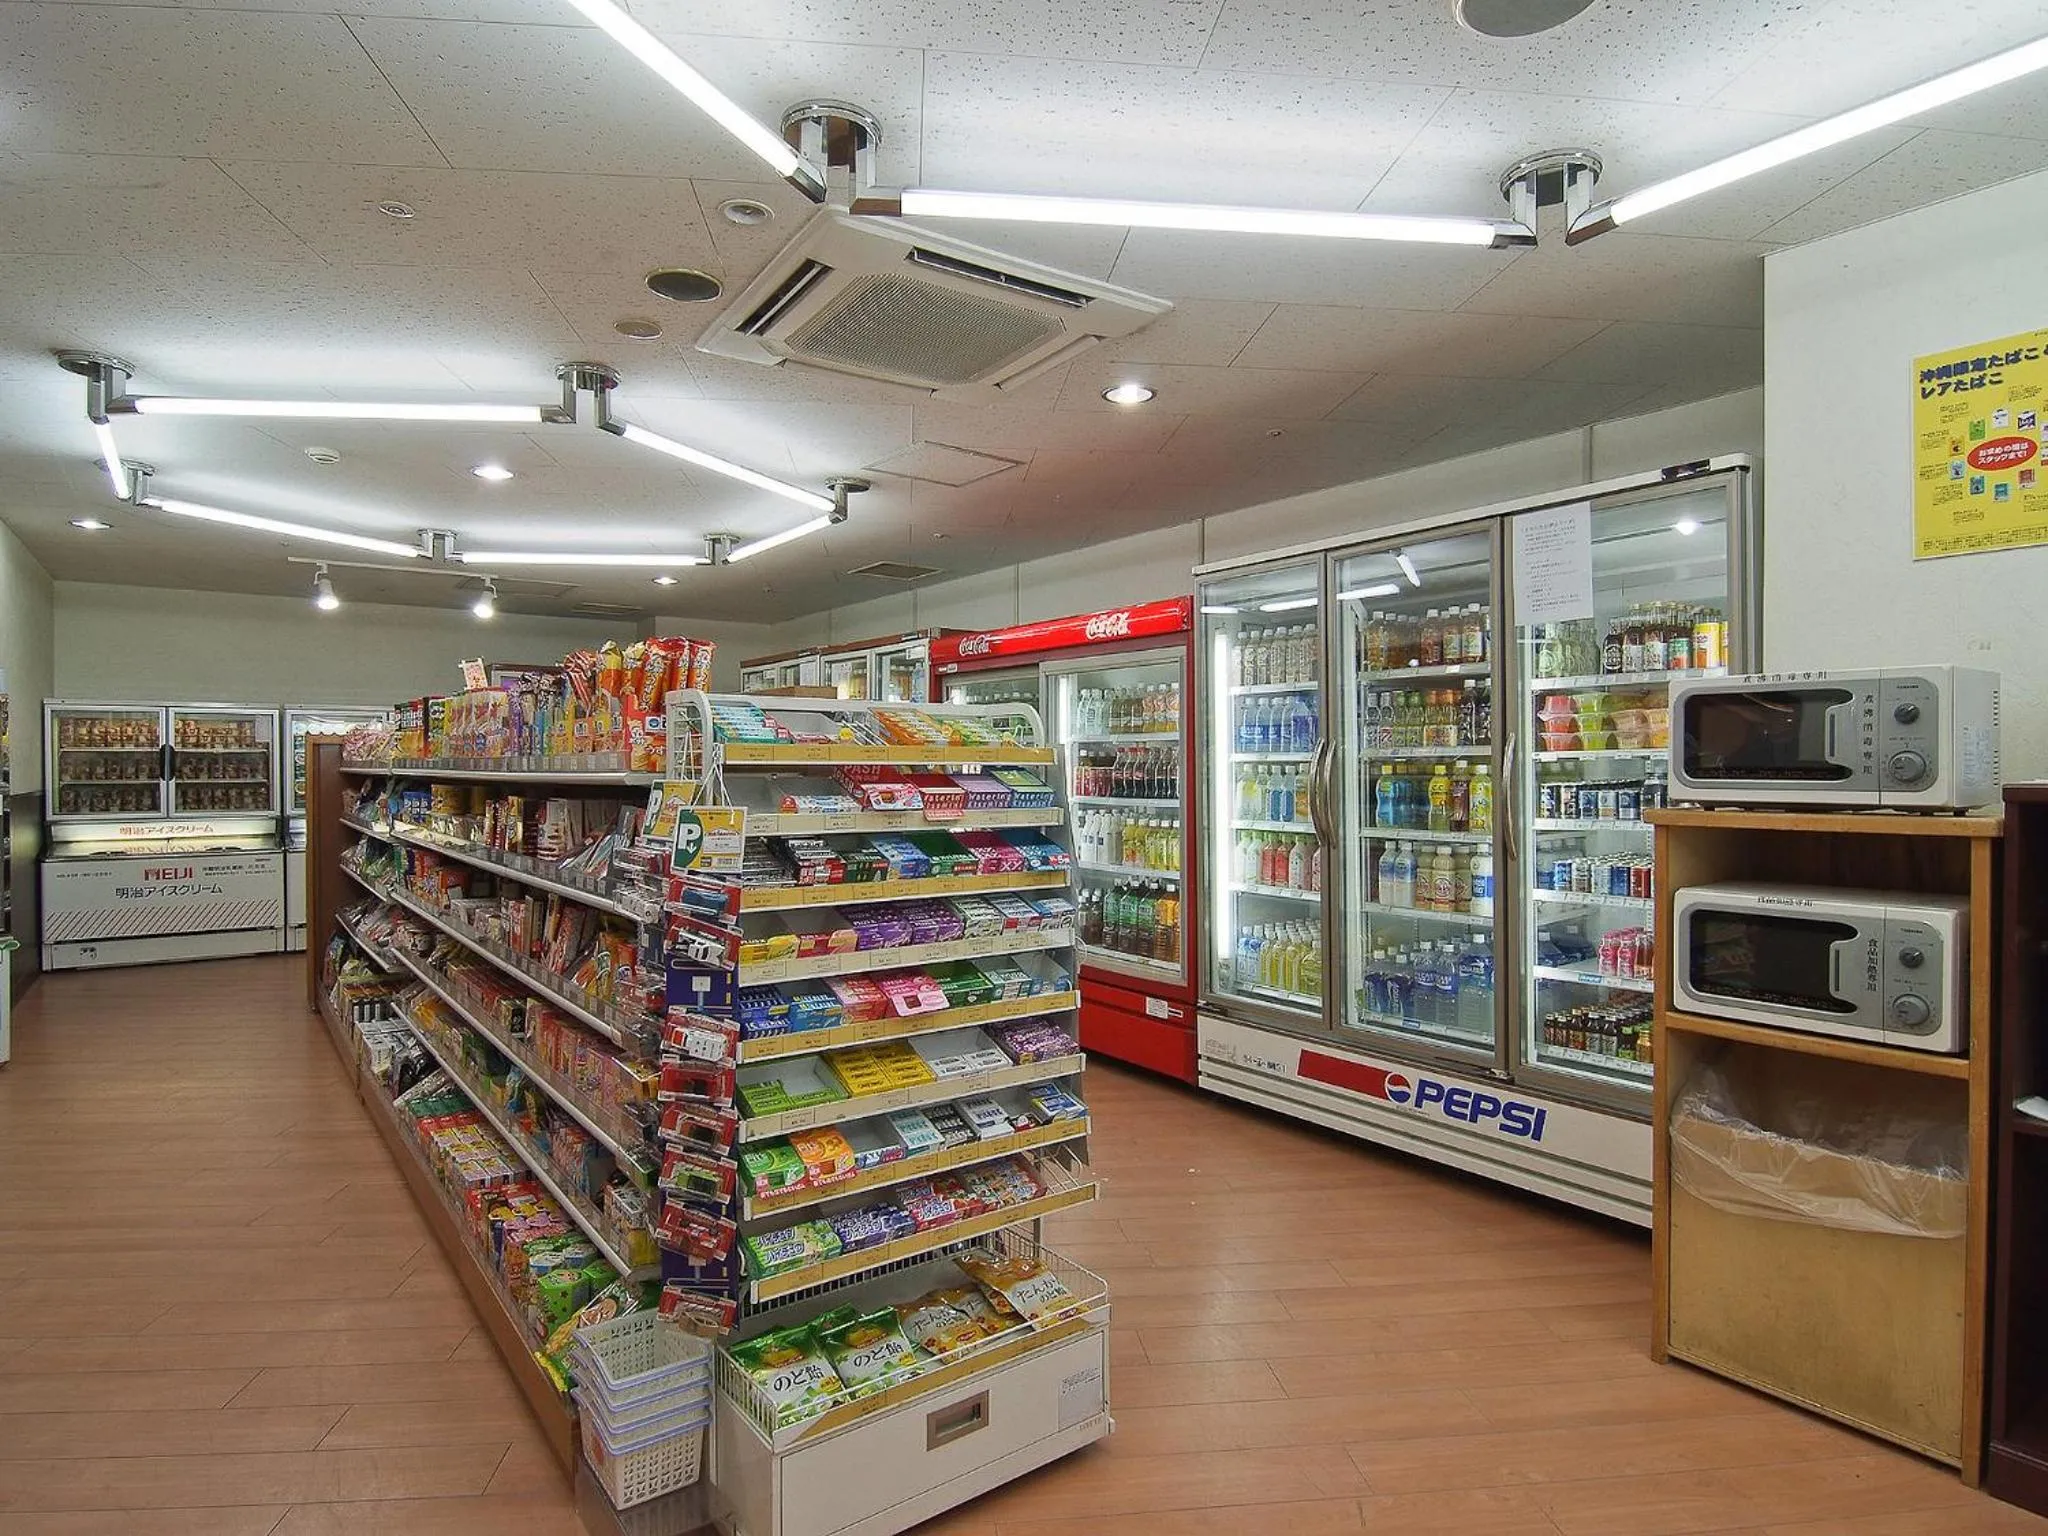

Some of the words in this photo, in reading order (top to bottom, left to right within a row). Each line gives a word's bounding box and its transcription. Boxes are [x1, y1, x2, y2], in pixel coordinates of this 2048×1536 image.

[1921, 372, 2003, 399] レアたばこ
[119, 824, 214, 836] 明治アイスクリーム
[144, 866, 193, 881] MEIJI
[115, 883, 223, 899] 明治アイスクリーム
[1413, 1078, 1549, 1143] PEPSI
[853, 1340, 906, 1368] のど飴
[773, 1364, 825, 1392] のど飴
